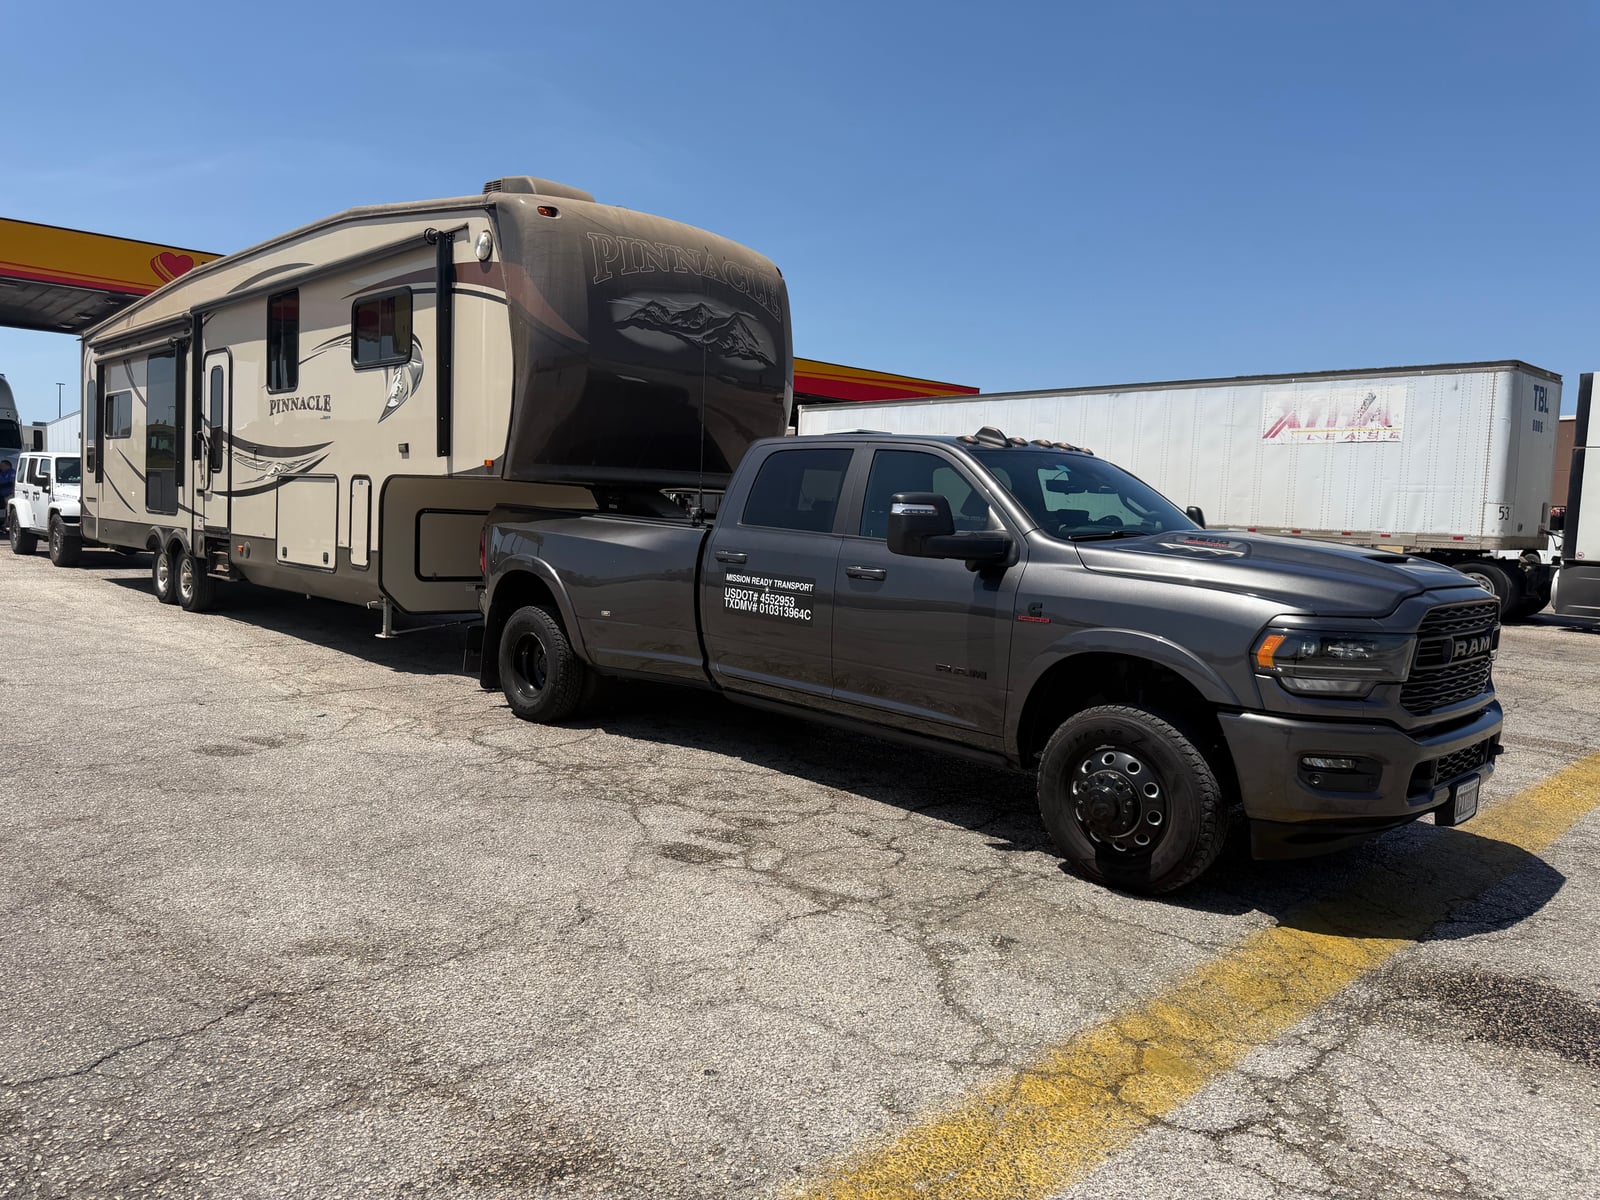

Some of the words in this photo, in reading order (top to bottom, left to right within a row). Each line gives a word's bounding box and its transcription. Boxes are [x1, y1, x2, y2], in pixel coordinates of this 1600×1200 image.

[587, 232, 781, 322] PINNACLE
[269, 394, 331, 416] PINNACLE
[1533, 385, 1549, 414] TBL
[1498, 506, 1510, 520] 53
[726, 573, 751, 584] MISSION
[751, 577, 773, 587] READY
[774, 580, 814, 592] TRANSPORT
[724, 587, 758, 602] USDOT#
[760, 593, 795, 607] 4552953
[724, 597, 758, 612] TXDMV#
[759, 604, 812, 621] 010313964C
[1453, 636, 1491, 657] RAM
